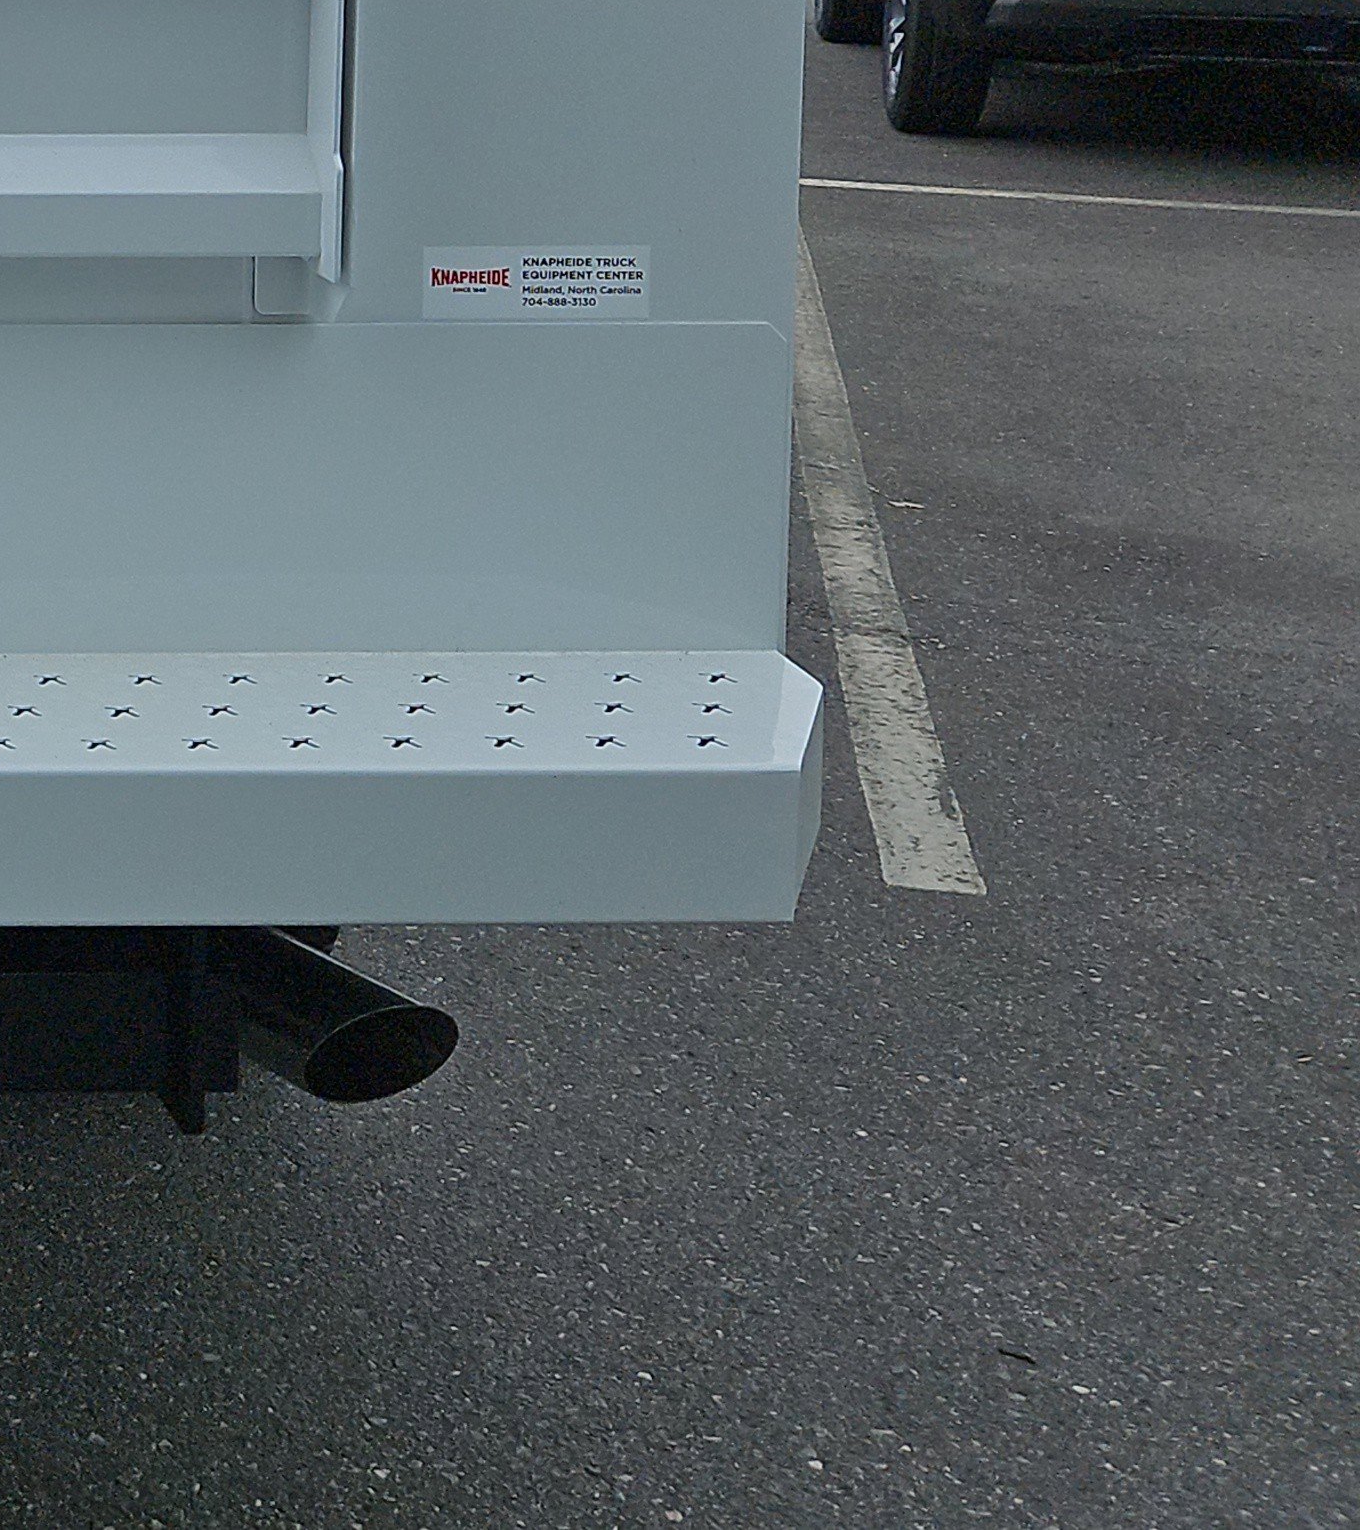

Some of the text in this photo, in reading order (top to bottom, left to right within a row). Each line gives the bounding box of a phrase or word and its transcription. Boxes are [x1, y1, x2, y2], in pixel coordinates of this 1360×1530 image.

[522, 257, 636, 267] KNAPHEIDE TRUCK
[431, 267, 510, 287] KNAPHEIDE
[522, 270, 644, 280] EQUIPMENT CENTER
[522, 285, 642, 295] Midland, North Carolina
[521, 297, 597, 307] 704-888-3130
